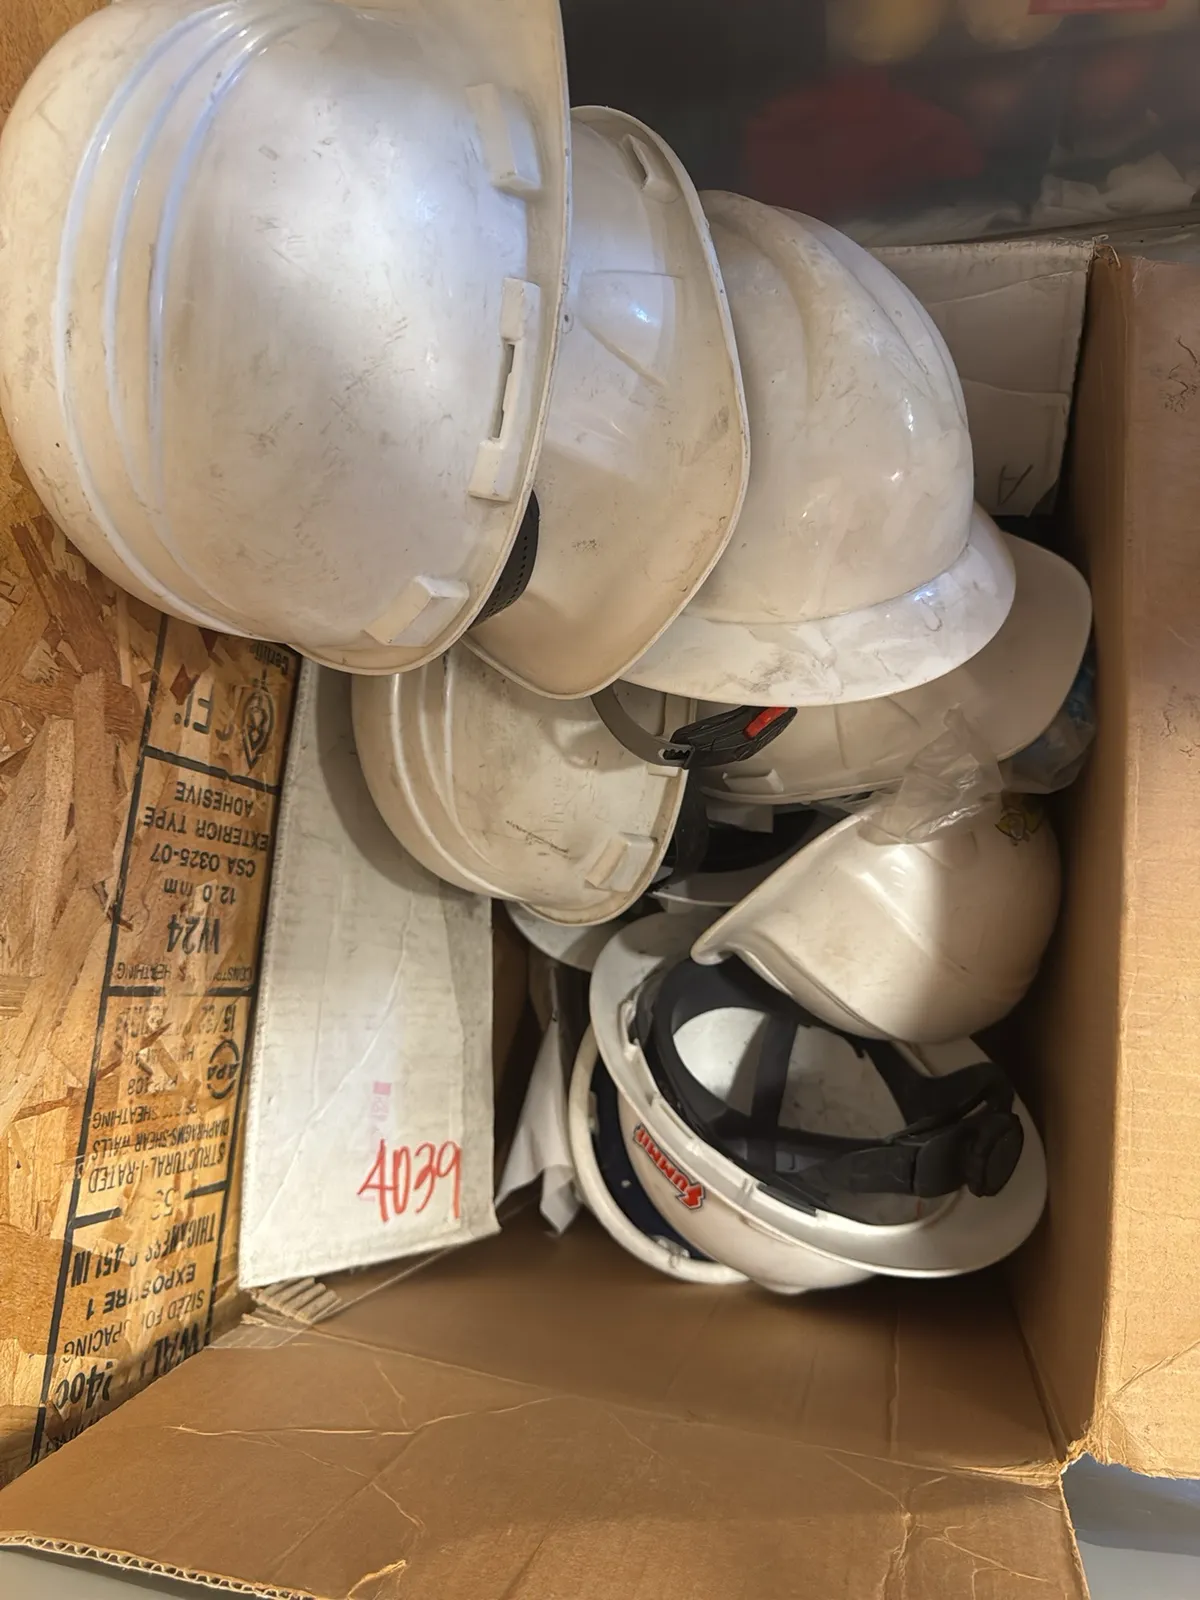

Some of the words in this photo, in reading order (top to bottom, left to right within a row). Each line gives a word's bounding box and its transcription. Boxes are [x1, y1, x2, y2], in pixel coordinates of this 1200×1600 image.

[175, 781, 254, 817] ADHESIVE
[143, 806, 187, 834] TYPE
[196, 819, 270, 851] EXTERIOR
[227, 857, 256, 878] CSA
[164, 878, 194, 897] mm
[203, 884, 236, 905] 12.0
[166, 914, 220, 955] W24
[207, 1063, 240, 1080] APA
[92, 1106, 158, 1129] SHEATHING
[357, 1139, 462, 1223] 4039
[103, 1262, 197, 1315] EXPOSURE
[86, 1298, 95, 1321] 1
[167, 1289, 206, 1320] SIZED
